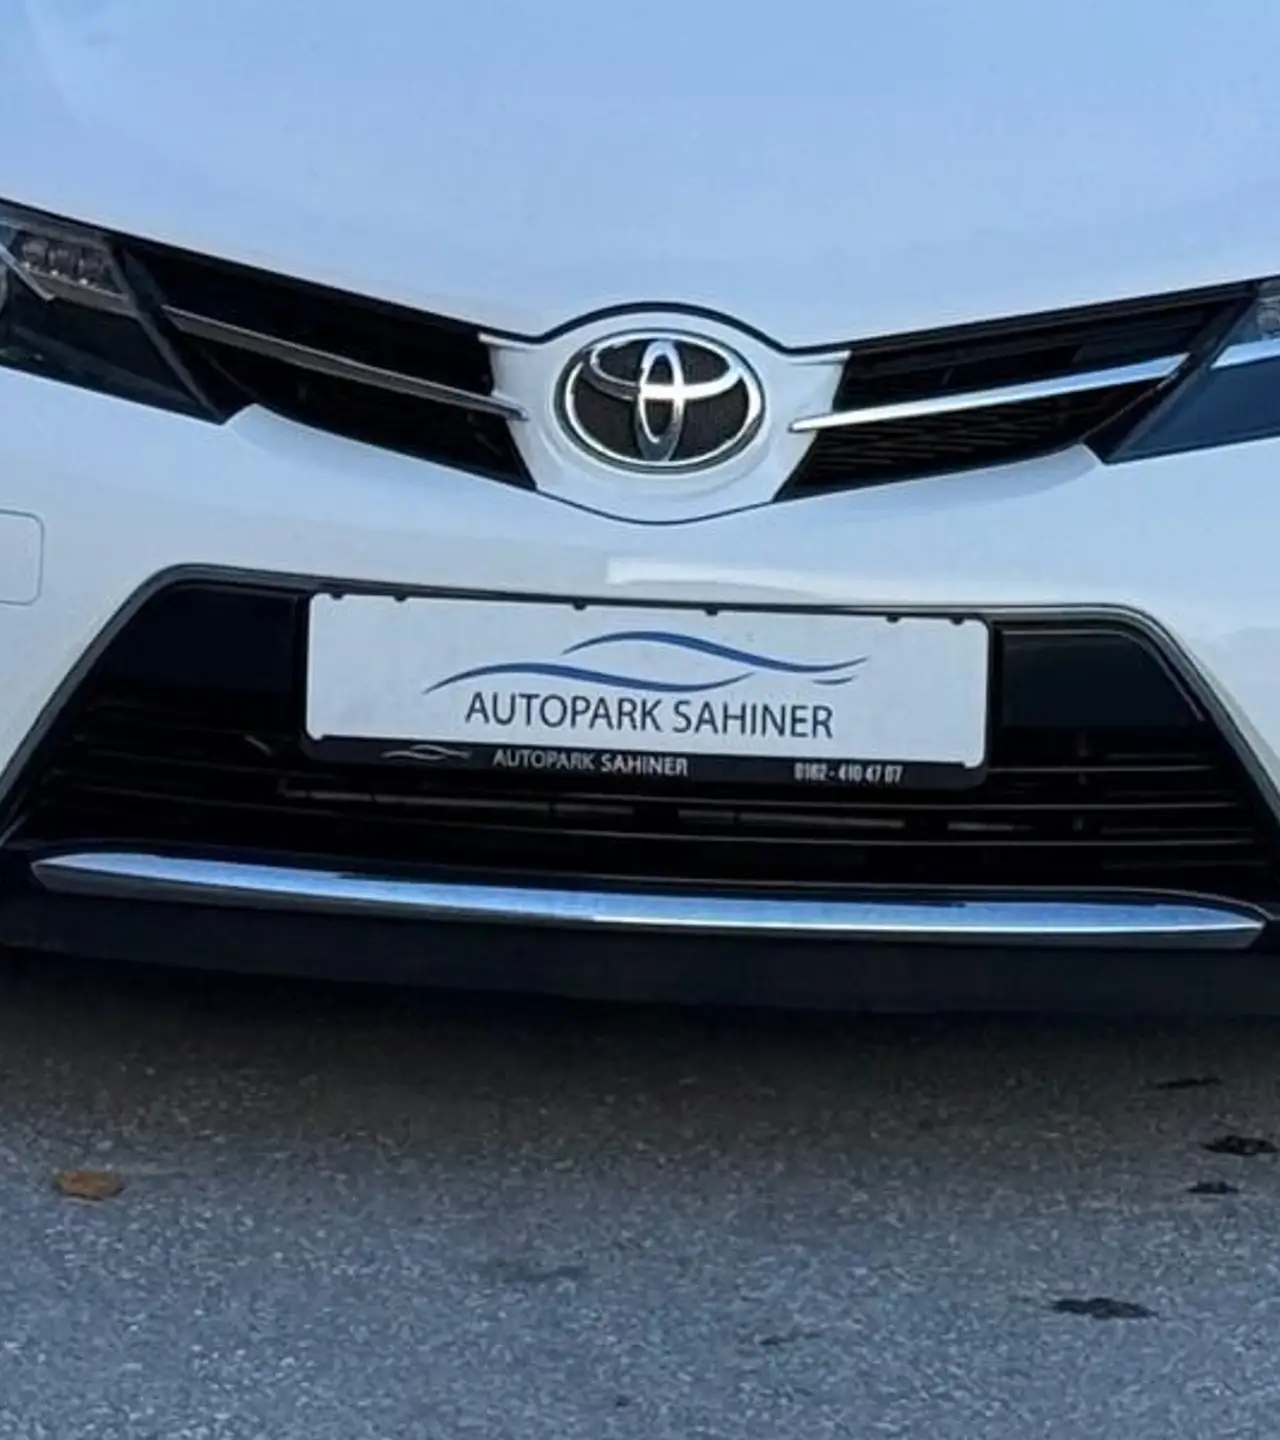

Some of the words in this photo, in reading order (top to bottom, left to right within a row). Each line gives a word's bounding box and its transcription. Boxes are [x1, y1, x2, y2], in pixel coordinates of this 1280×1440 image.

[465, 691, 662, 733] AUTOPARK
[672, 699, 834, 740] SAHINER
[492, 748, 596, 771] AUTOPARK
[601, 753, 689, 777] SAHINER
